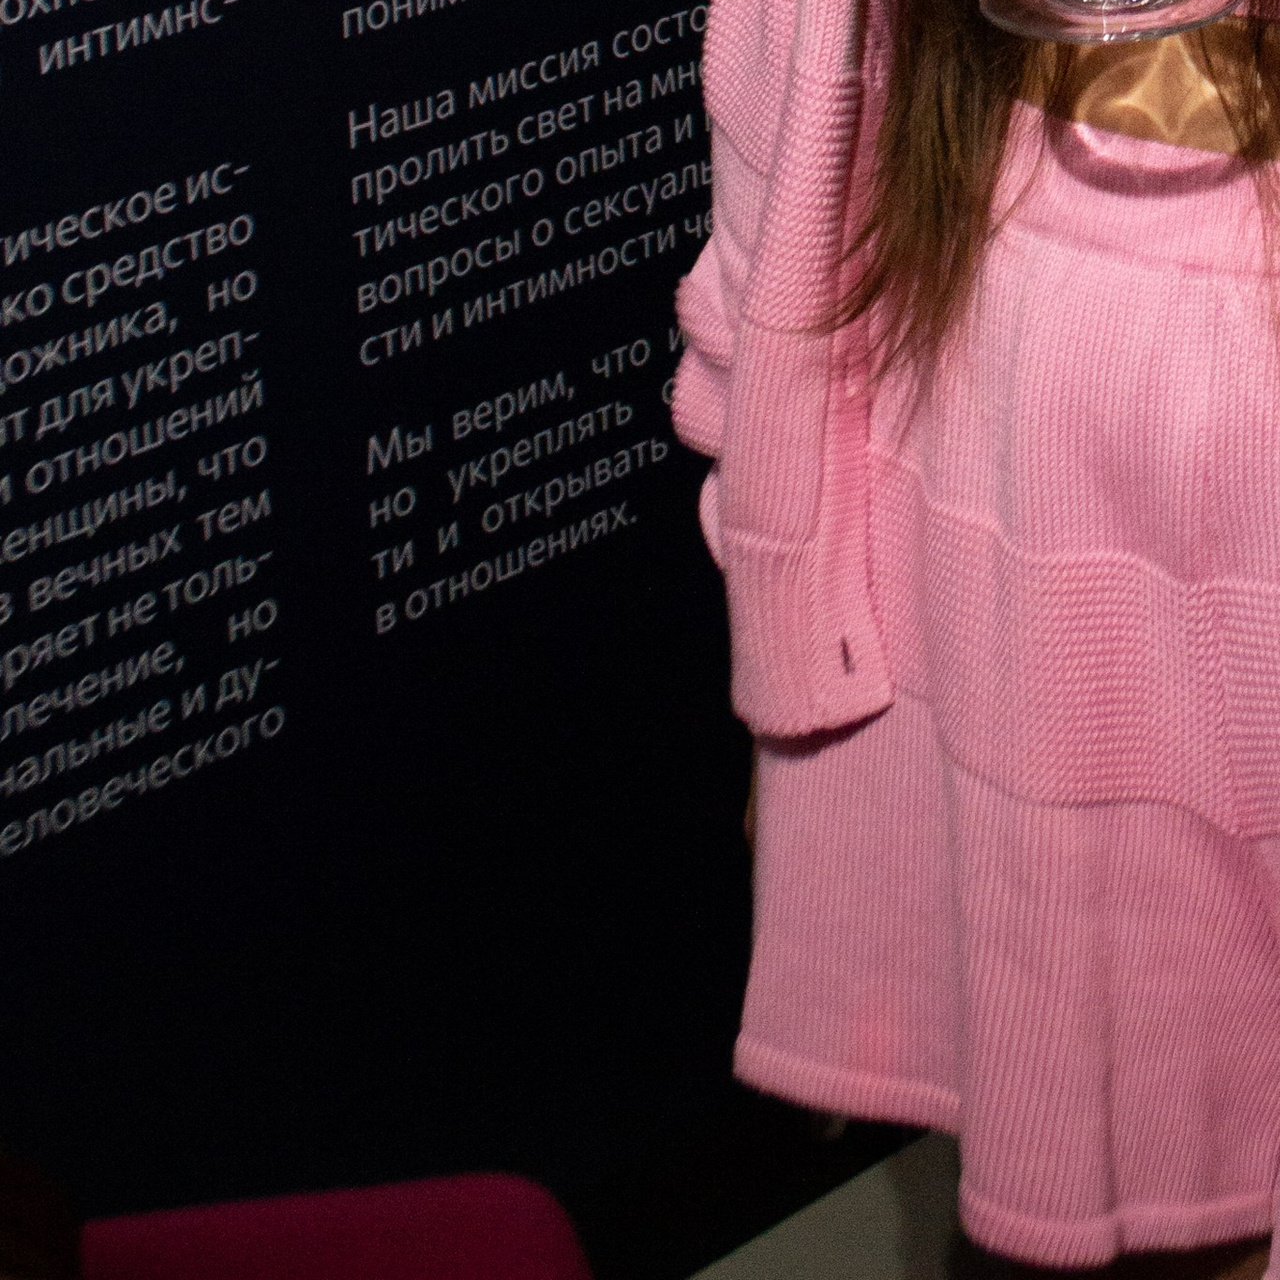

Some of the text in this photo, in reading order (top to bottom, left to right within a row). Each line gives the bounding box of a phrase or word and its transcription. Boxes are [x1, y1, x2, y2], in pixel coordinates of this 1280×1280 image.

[348, 89, 455, 149] Наша
[469, 41, 599, 108] миссия
[351, 60, 705, 205] пролить свет на мн
[186, 163, 250, 204] ис-
[353, 168, 544, 256] тического
[556, 125, 662, 184] опыта
[675, 114, 692, 143] и
[62, 214, 254, 307] средство
[358, 230, 520, 313] вопросы
[532, 218, 554, 246] о
[360, 320, 421, 366] сти
[433, 308, 452, 339] и
[464, 224, 675, 327] интимности
[0, 270, 257, 395] ожника, но
[36, 377, 114, 440] для
[121, 331, 259, 409] укреп-
[26, 370, 265, 493] отношений
[367, 426, 432, 474] Мы
[453, 372, 574, 440] верим,
[592, 339, 650, 377] что
[370, 402, 632, 527] но укреплять
[0, 471, 187, 564] енщины,
[198, 436, 267, 480] что
[29, 525, 181, 611] вечных
[197, 489, 271, 540] тем
[372, 439, 667, 578] ти и открывать
[0, 552, 272, 689] ряет не толь-
[229, 600, 277, 641] но
[377, 503, 636, 633] в отношениях.
[183, 684, 205, 718] и
[216, 660, 278, 710] ду-
